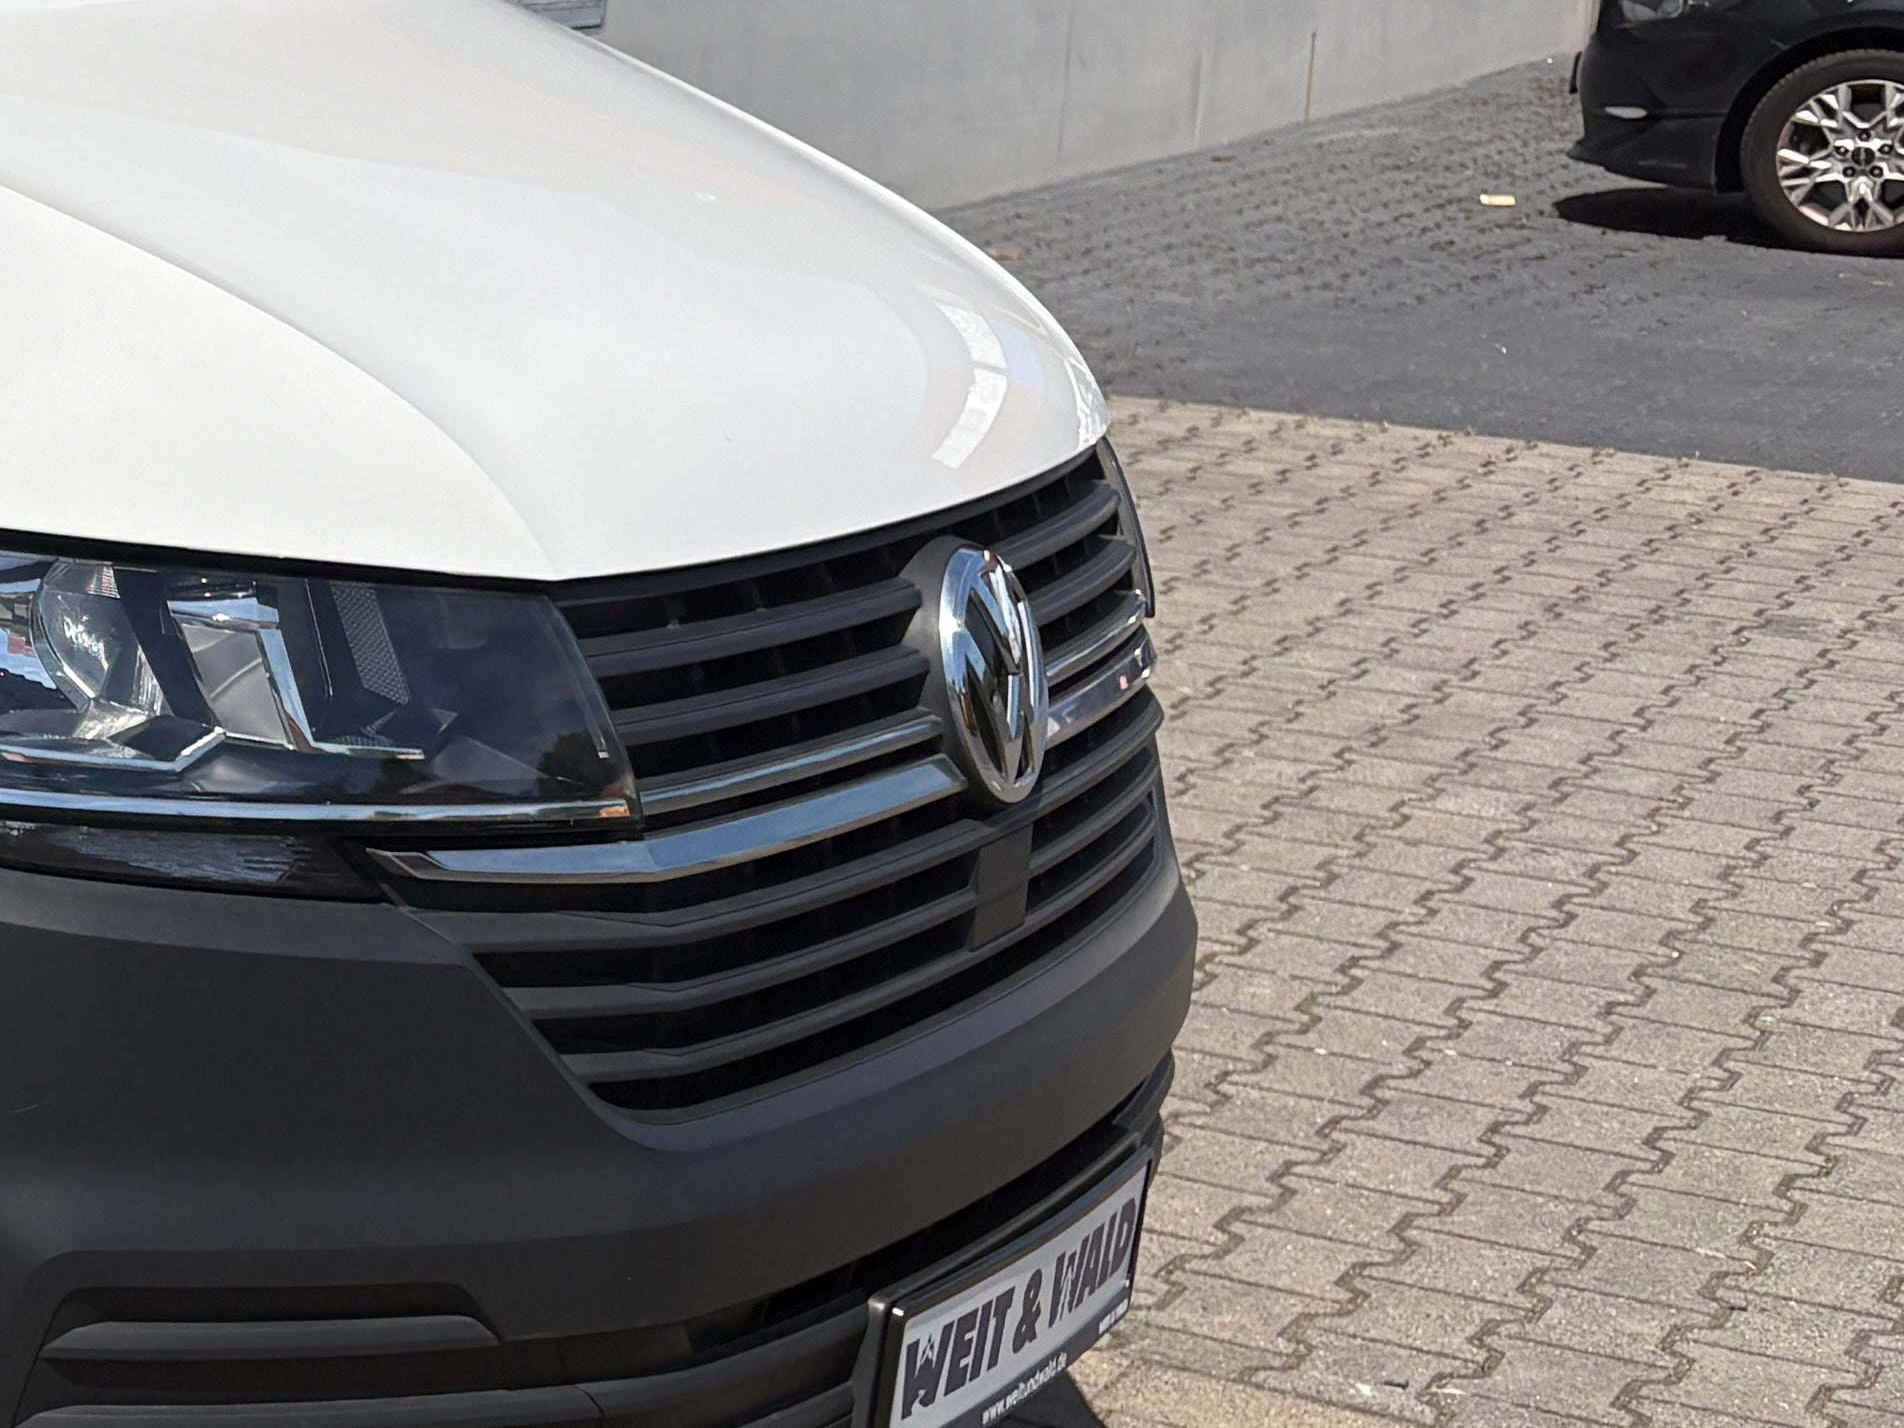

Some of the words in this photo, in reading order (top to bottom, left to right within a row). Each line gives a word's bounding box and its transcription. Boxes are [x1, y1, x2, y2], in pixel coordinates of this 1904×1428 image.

[901, 1282, 1016, 1421] WEIT
[1012, 1268, 1044, 1355] &
[1048, 1197, 1137, 1329] WALD
